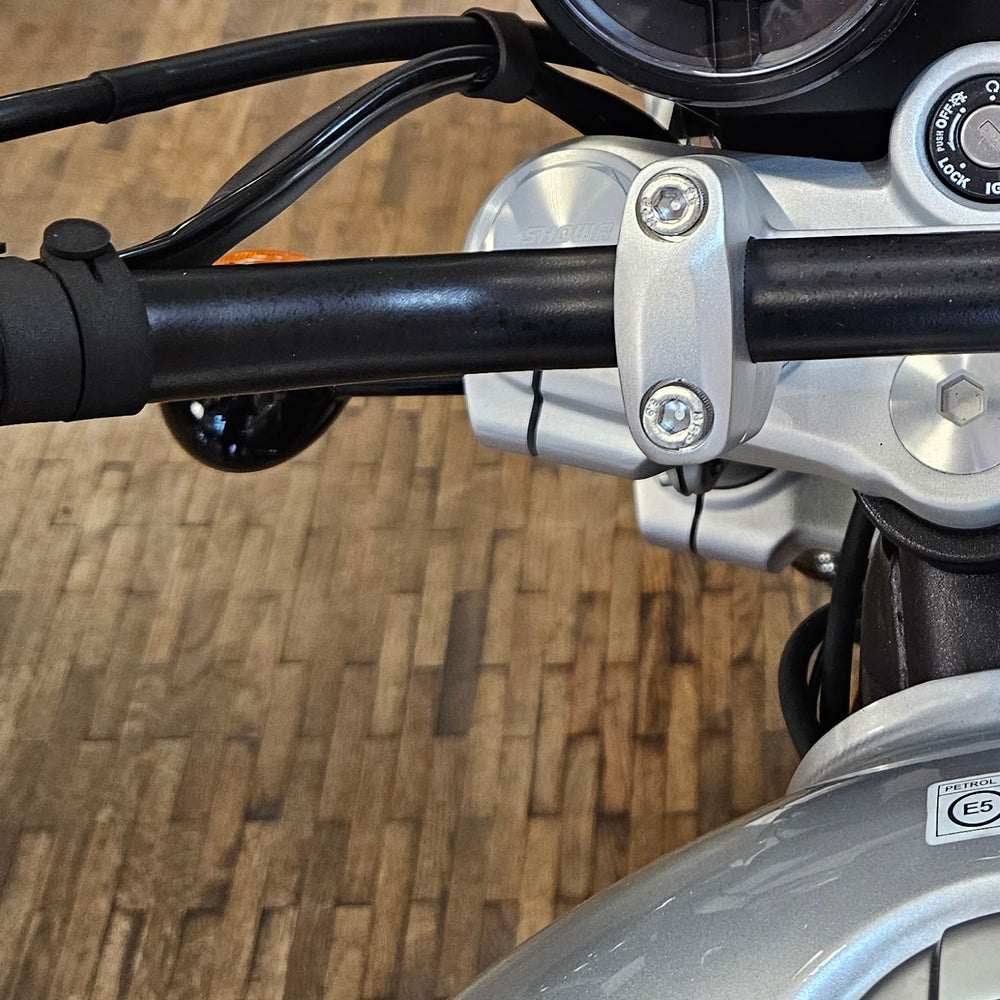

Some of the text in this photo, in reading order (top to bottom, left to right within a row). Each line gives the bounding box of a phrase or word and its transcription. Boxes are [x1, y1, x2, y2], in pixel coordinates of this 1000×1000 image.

[935, 103, 954, 129] OFF
[935, 130, 945, 152] PUSH
[938, 157, 970, 189] LOCK
[520, 220, 615, 245] SHOWA
[945, 777, 997, 792] PETROL
[963, 800, 994, 816] E5
